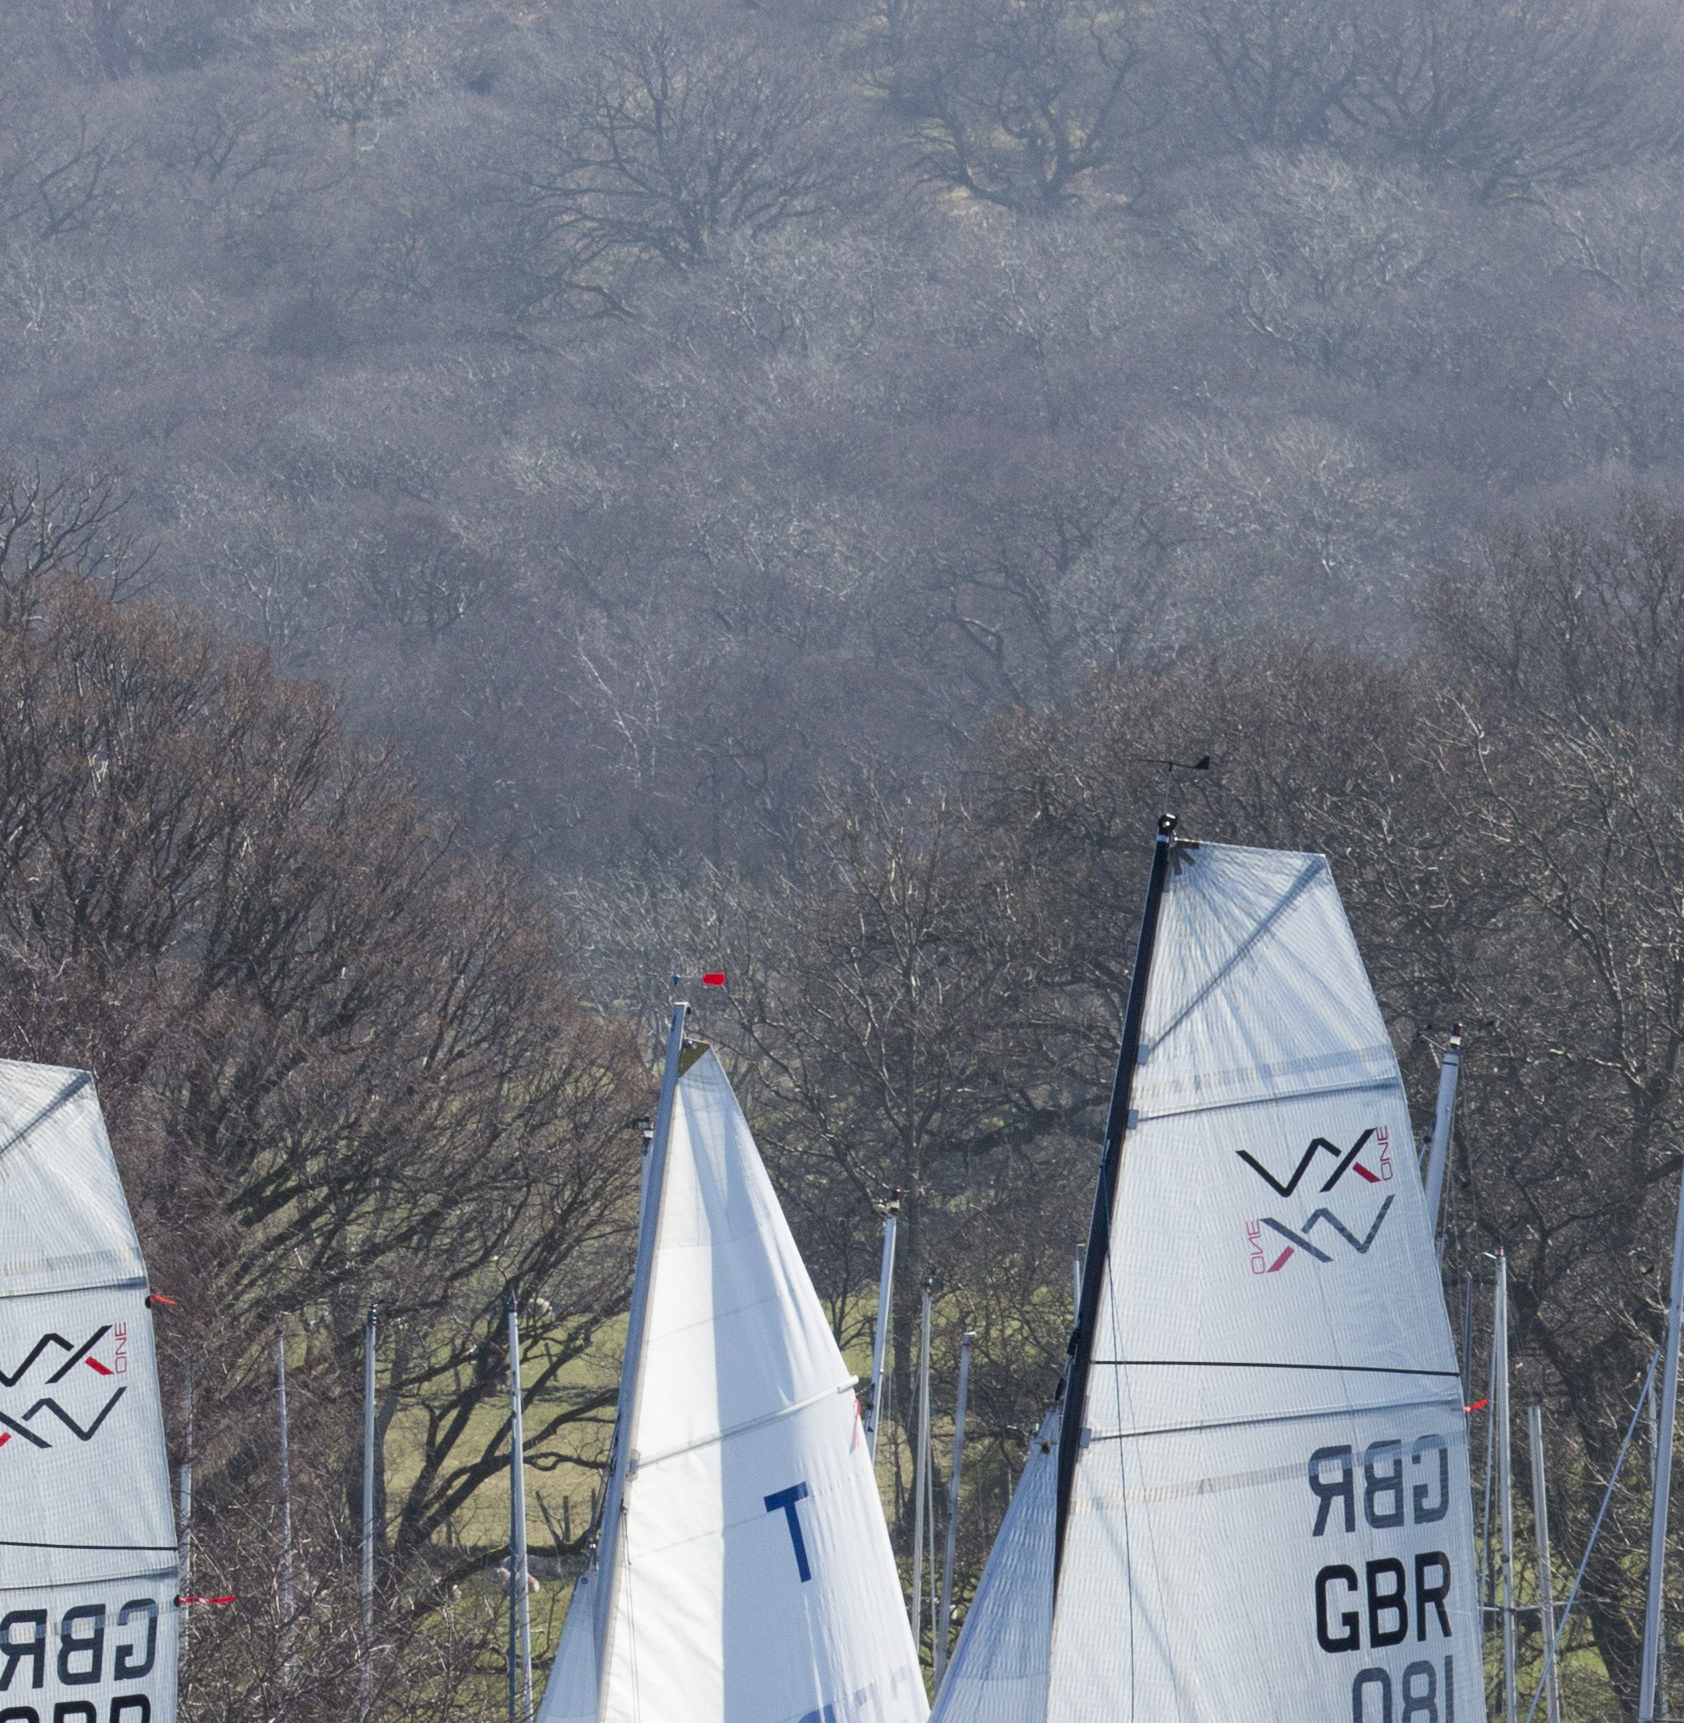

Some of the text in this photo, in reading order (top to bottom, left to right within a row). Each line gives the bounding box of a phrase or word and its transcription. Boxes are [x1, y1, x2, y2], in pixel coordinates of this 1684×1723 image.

[1378, 1124, 1394, 1183] ONE
[114, 1320, 128, 1374] ONE
[763, 1481, 812, 1584] T
[1315, 1550, 1454, 1654] GBR
